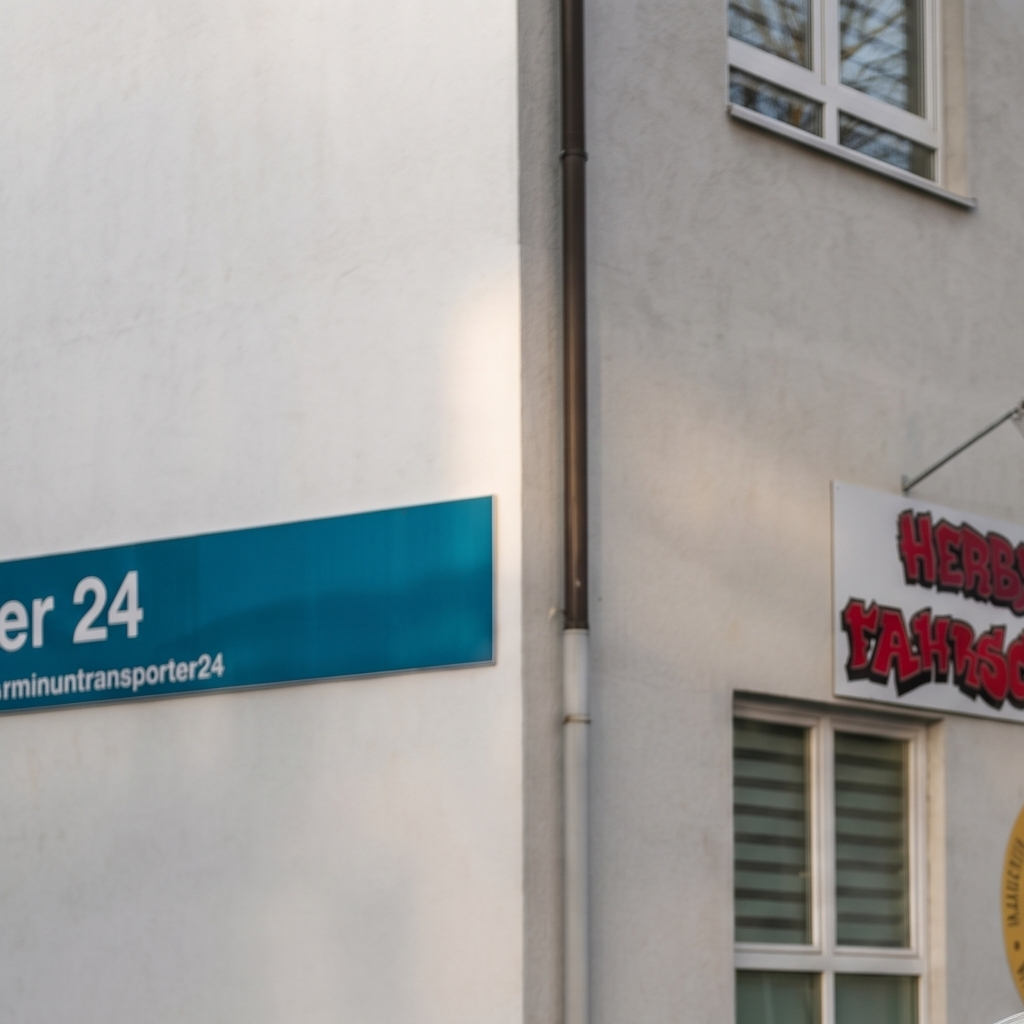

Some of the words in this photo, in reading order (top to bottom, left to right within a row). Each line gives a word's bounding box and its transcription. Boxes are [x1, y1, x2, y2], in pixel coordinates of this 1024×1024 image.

[0, 595, 55, 653] er
[72, 569, 145, 645] 24
[0, 652, 226, 702] rminuntransporter24
